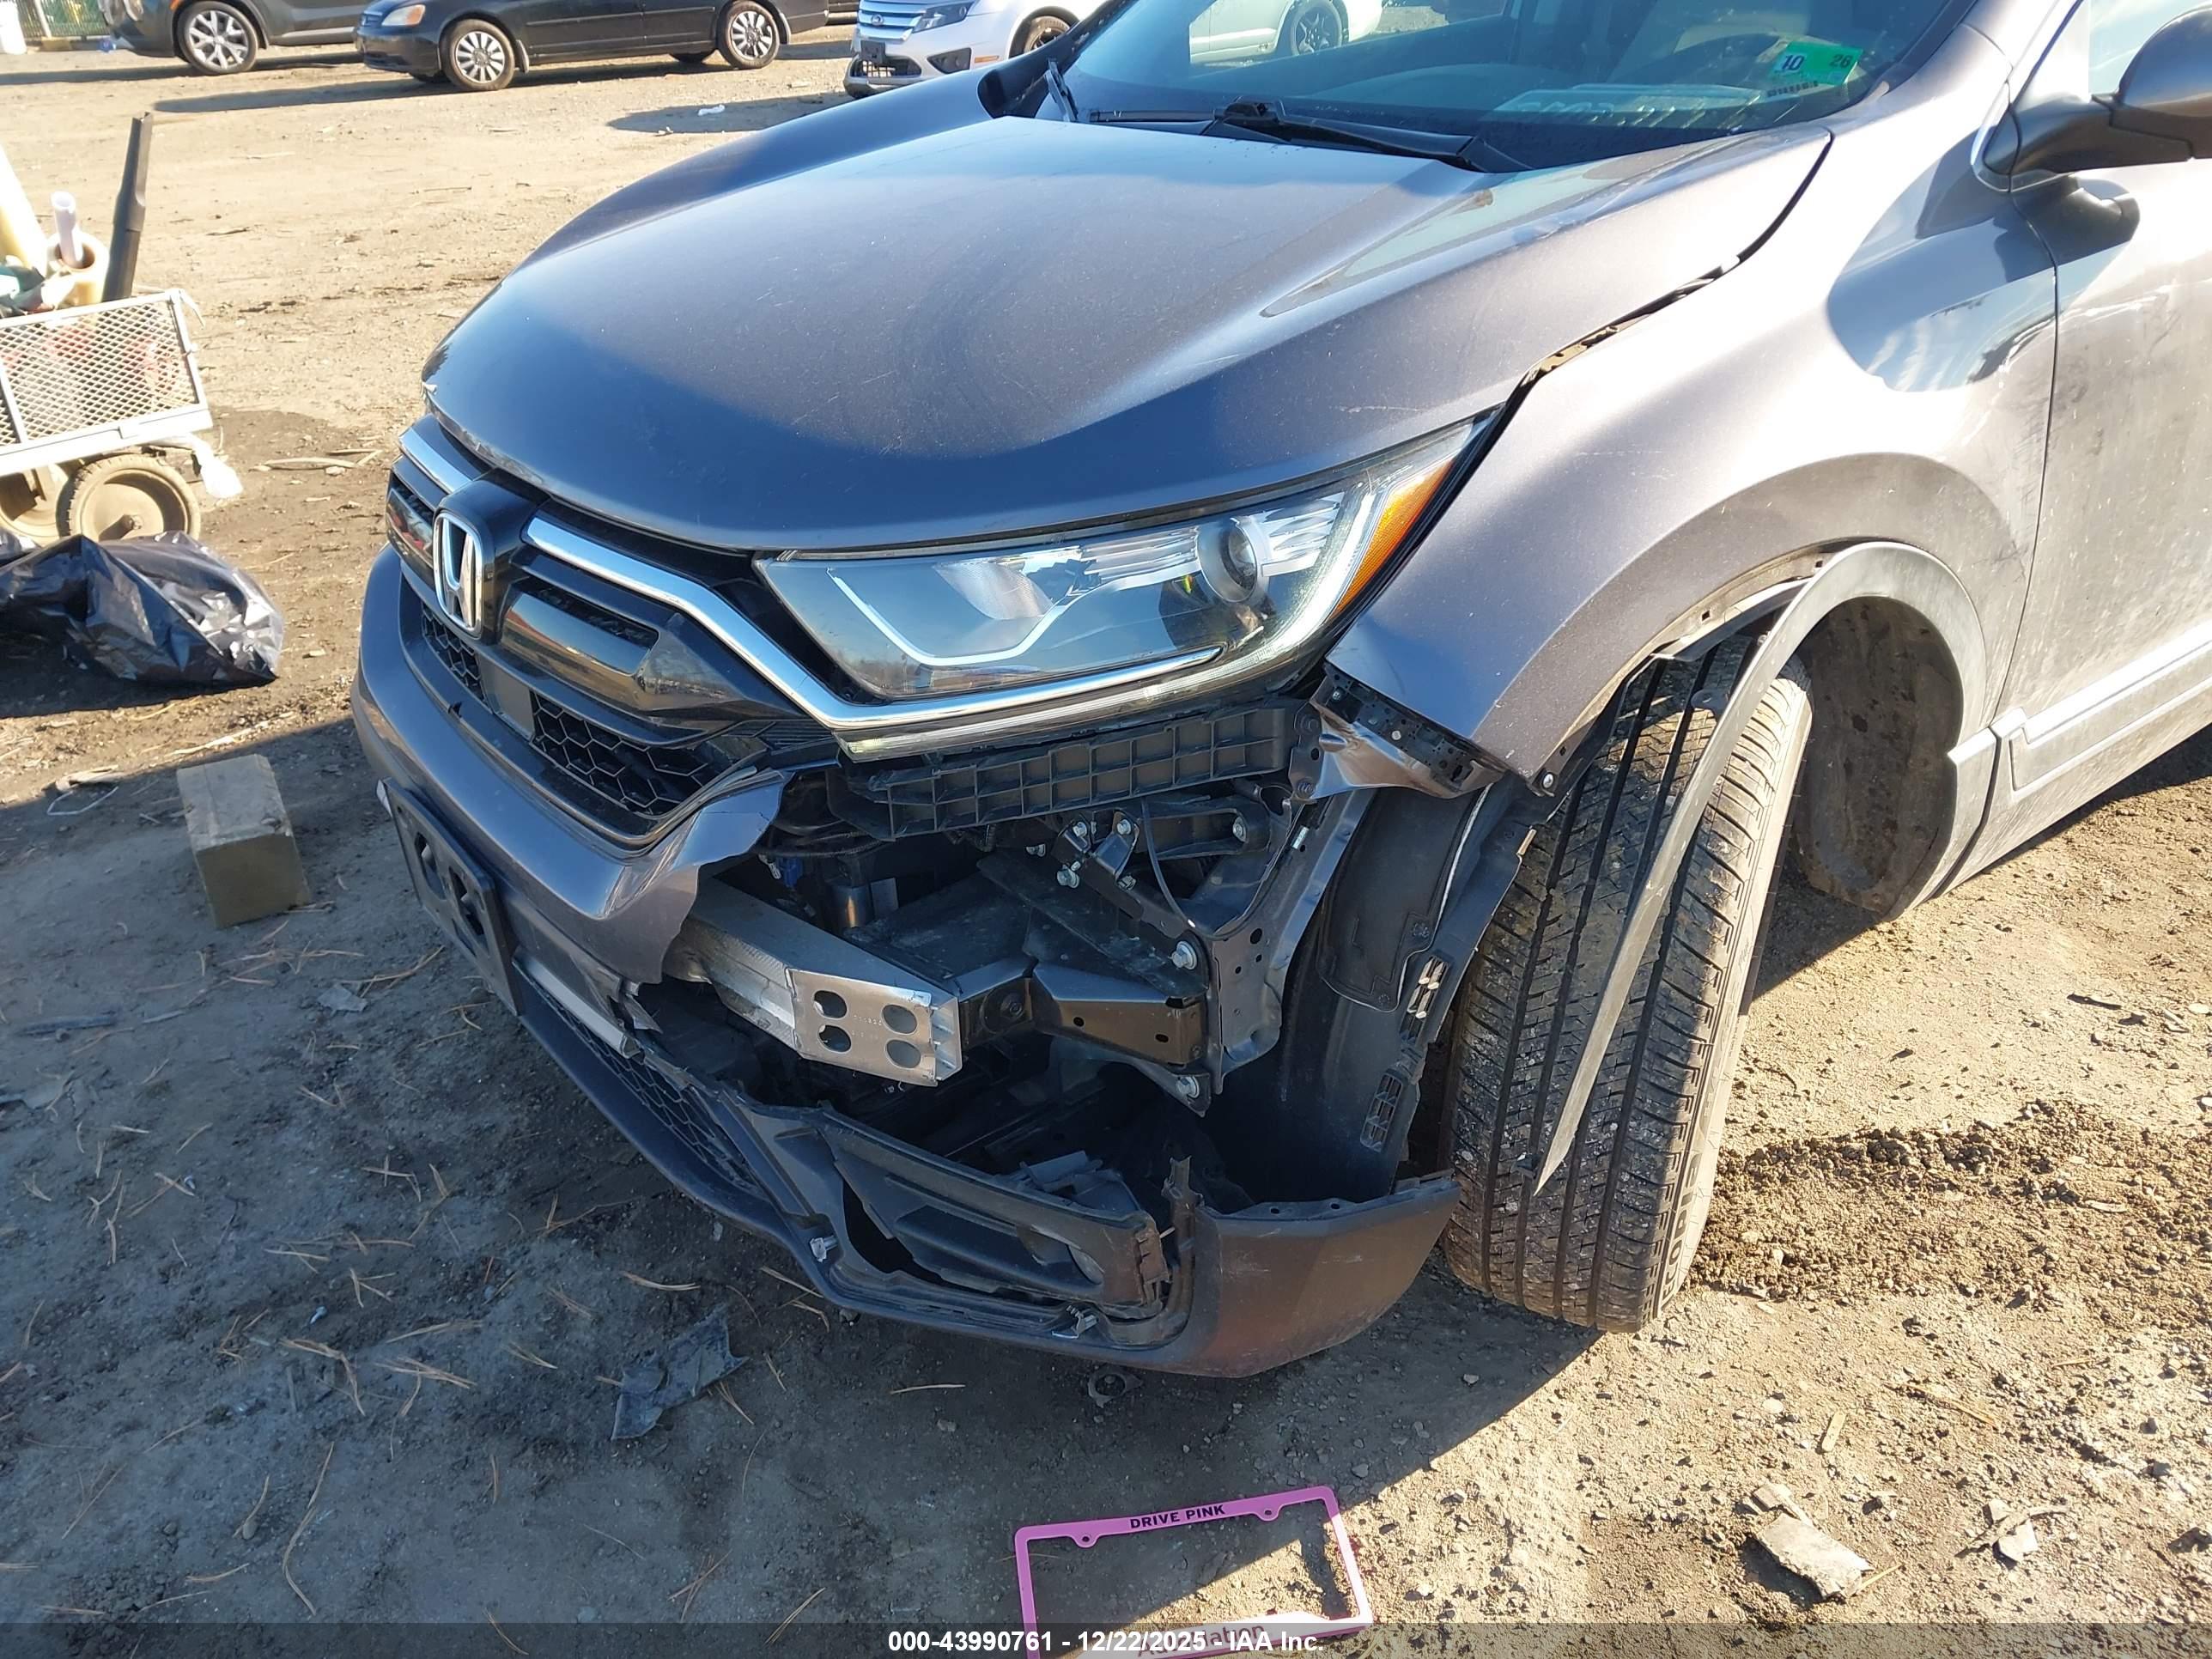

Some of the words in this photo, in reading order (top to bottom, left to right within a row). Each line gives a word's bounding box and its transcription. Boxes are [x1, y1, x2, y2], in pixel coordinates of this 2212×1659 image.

[1782, 54, 1805, 71] 10
[1130, 1511, 1181, 1529] DRIVE
[1186, 1504, 1225, 1521] PINK
